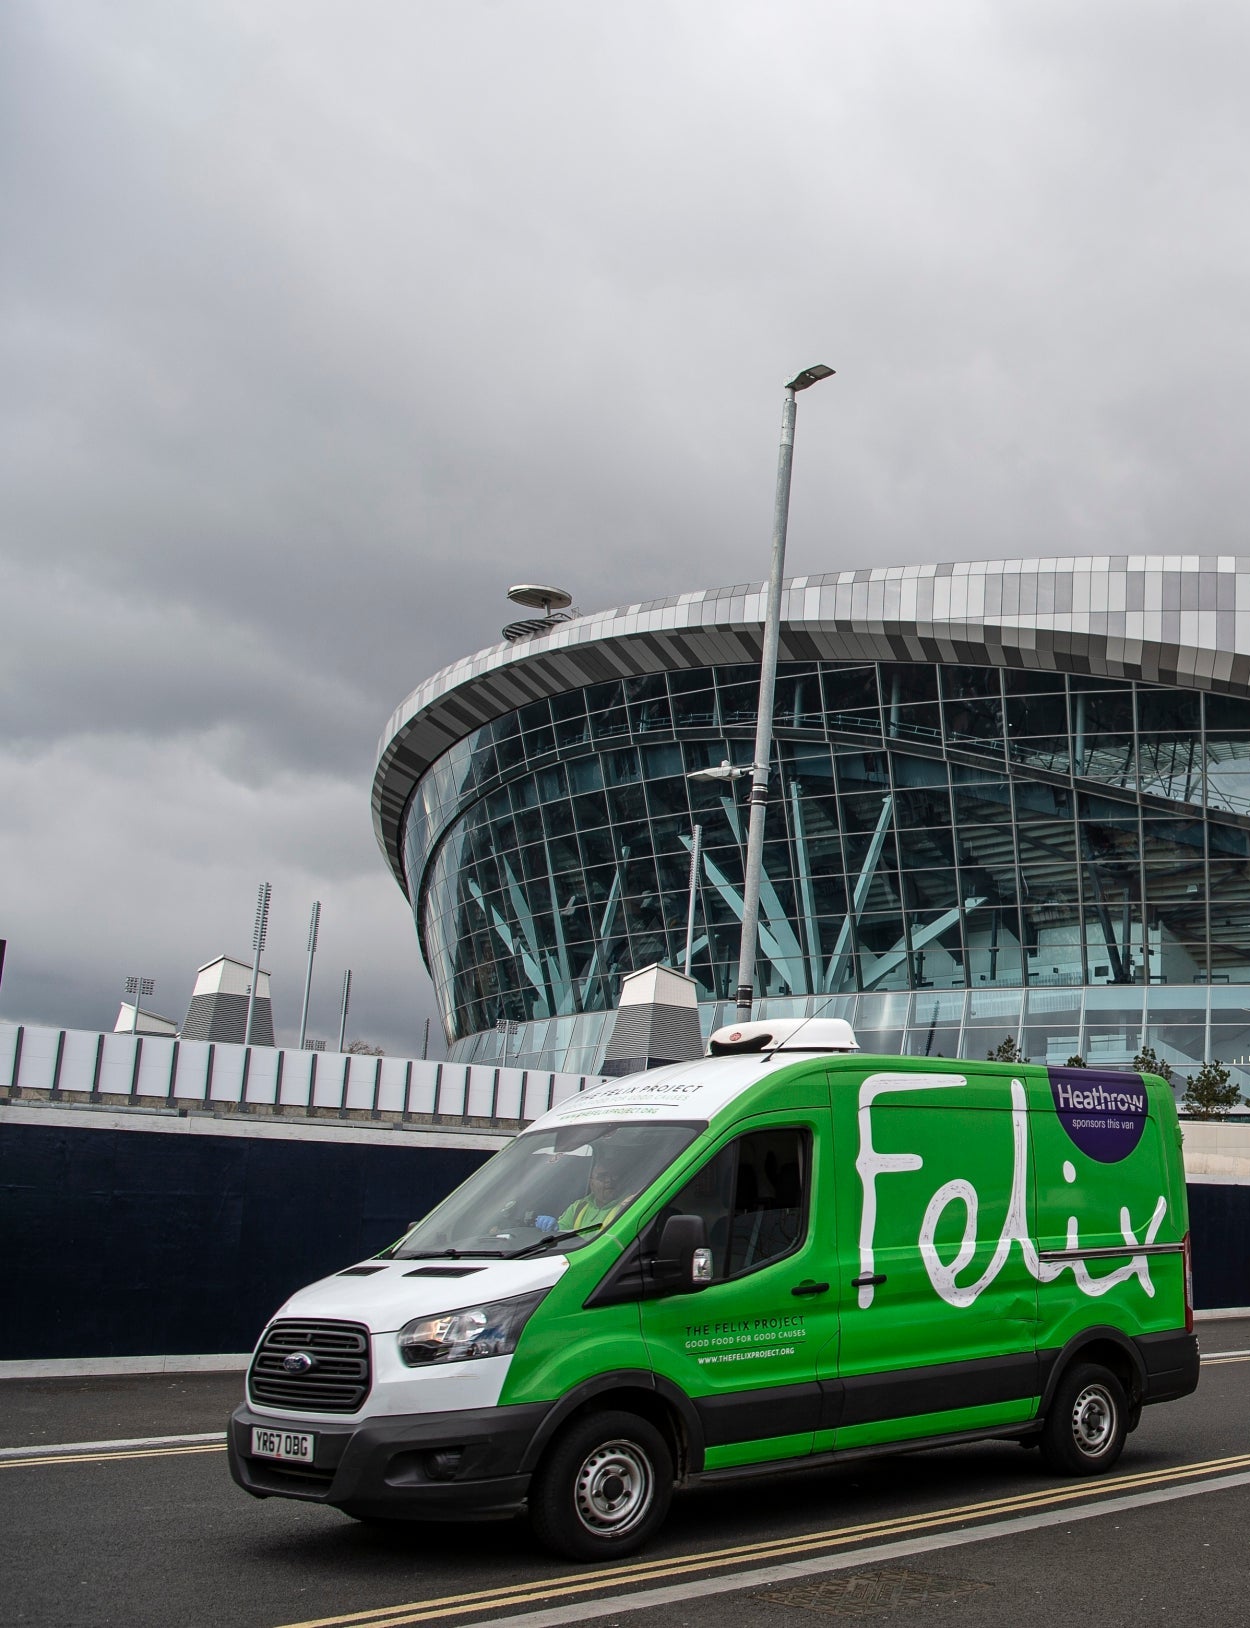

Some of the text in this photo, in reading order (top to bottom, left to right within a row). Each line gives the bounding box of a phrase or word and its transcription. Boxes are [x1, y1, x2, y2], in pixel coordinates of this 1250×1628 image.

[601, 1086, 640, 1098] FELIX
[640, 1083, 704, 1094] PROJECT
[1057, 1083, 1144, 1112] Heathrow
[1072, 1119, 1134, 1130] sponsors this van
[855, 1072, 1168, 1310] Felix
[686, 1315, 805, 1336] THE FELIX PROJECT
[685, 1329, 806, 1348] GOOD FOOD FOR GOOD CAUSES
[698, 1347, 795, 1364] WWW.THEFELIXPROJECT.ORG
[256, 1430, 282, 1453] YR67
